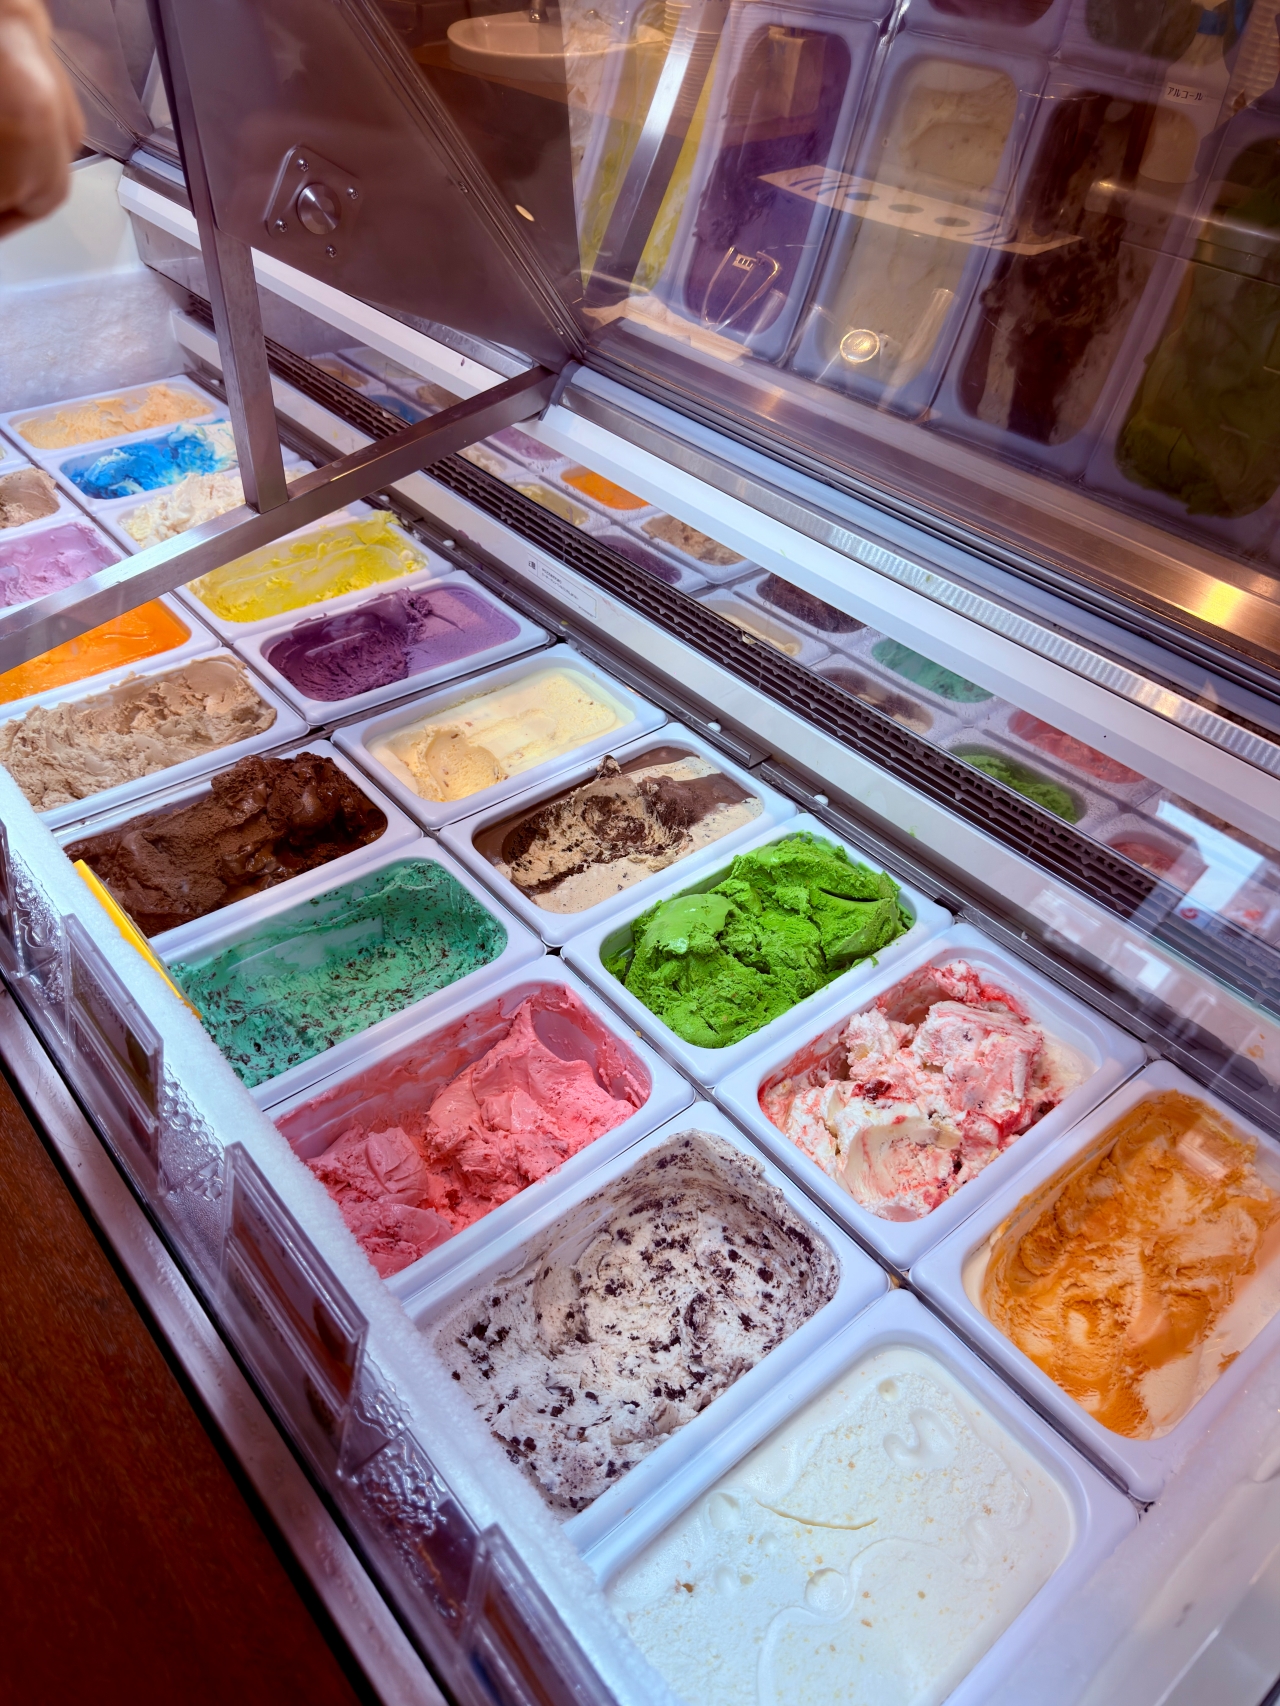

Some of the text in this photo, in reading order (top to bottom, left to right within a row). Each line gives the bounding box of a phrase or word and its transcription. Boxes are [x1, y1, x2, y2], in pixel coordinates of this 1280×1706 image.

[1167, 86, 1203, 101] アルコール
